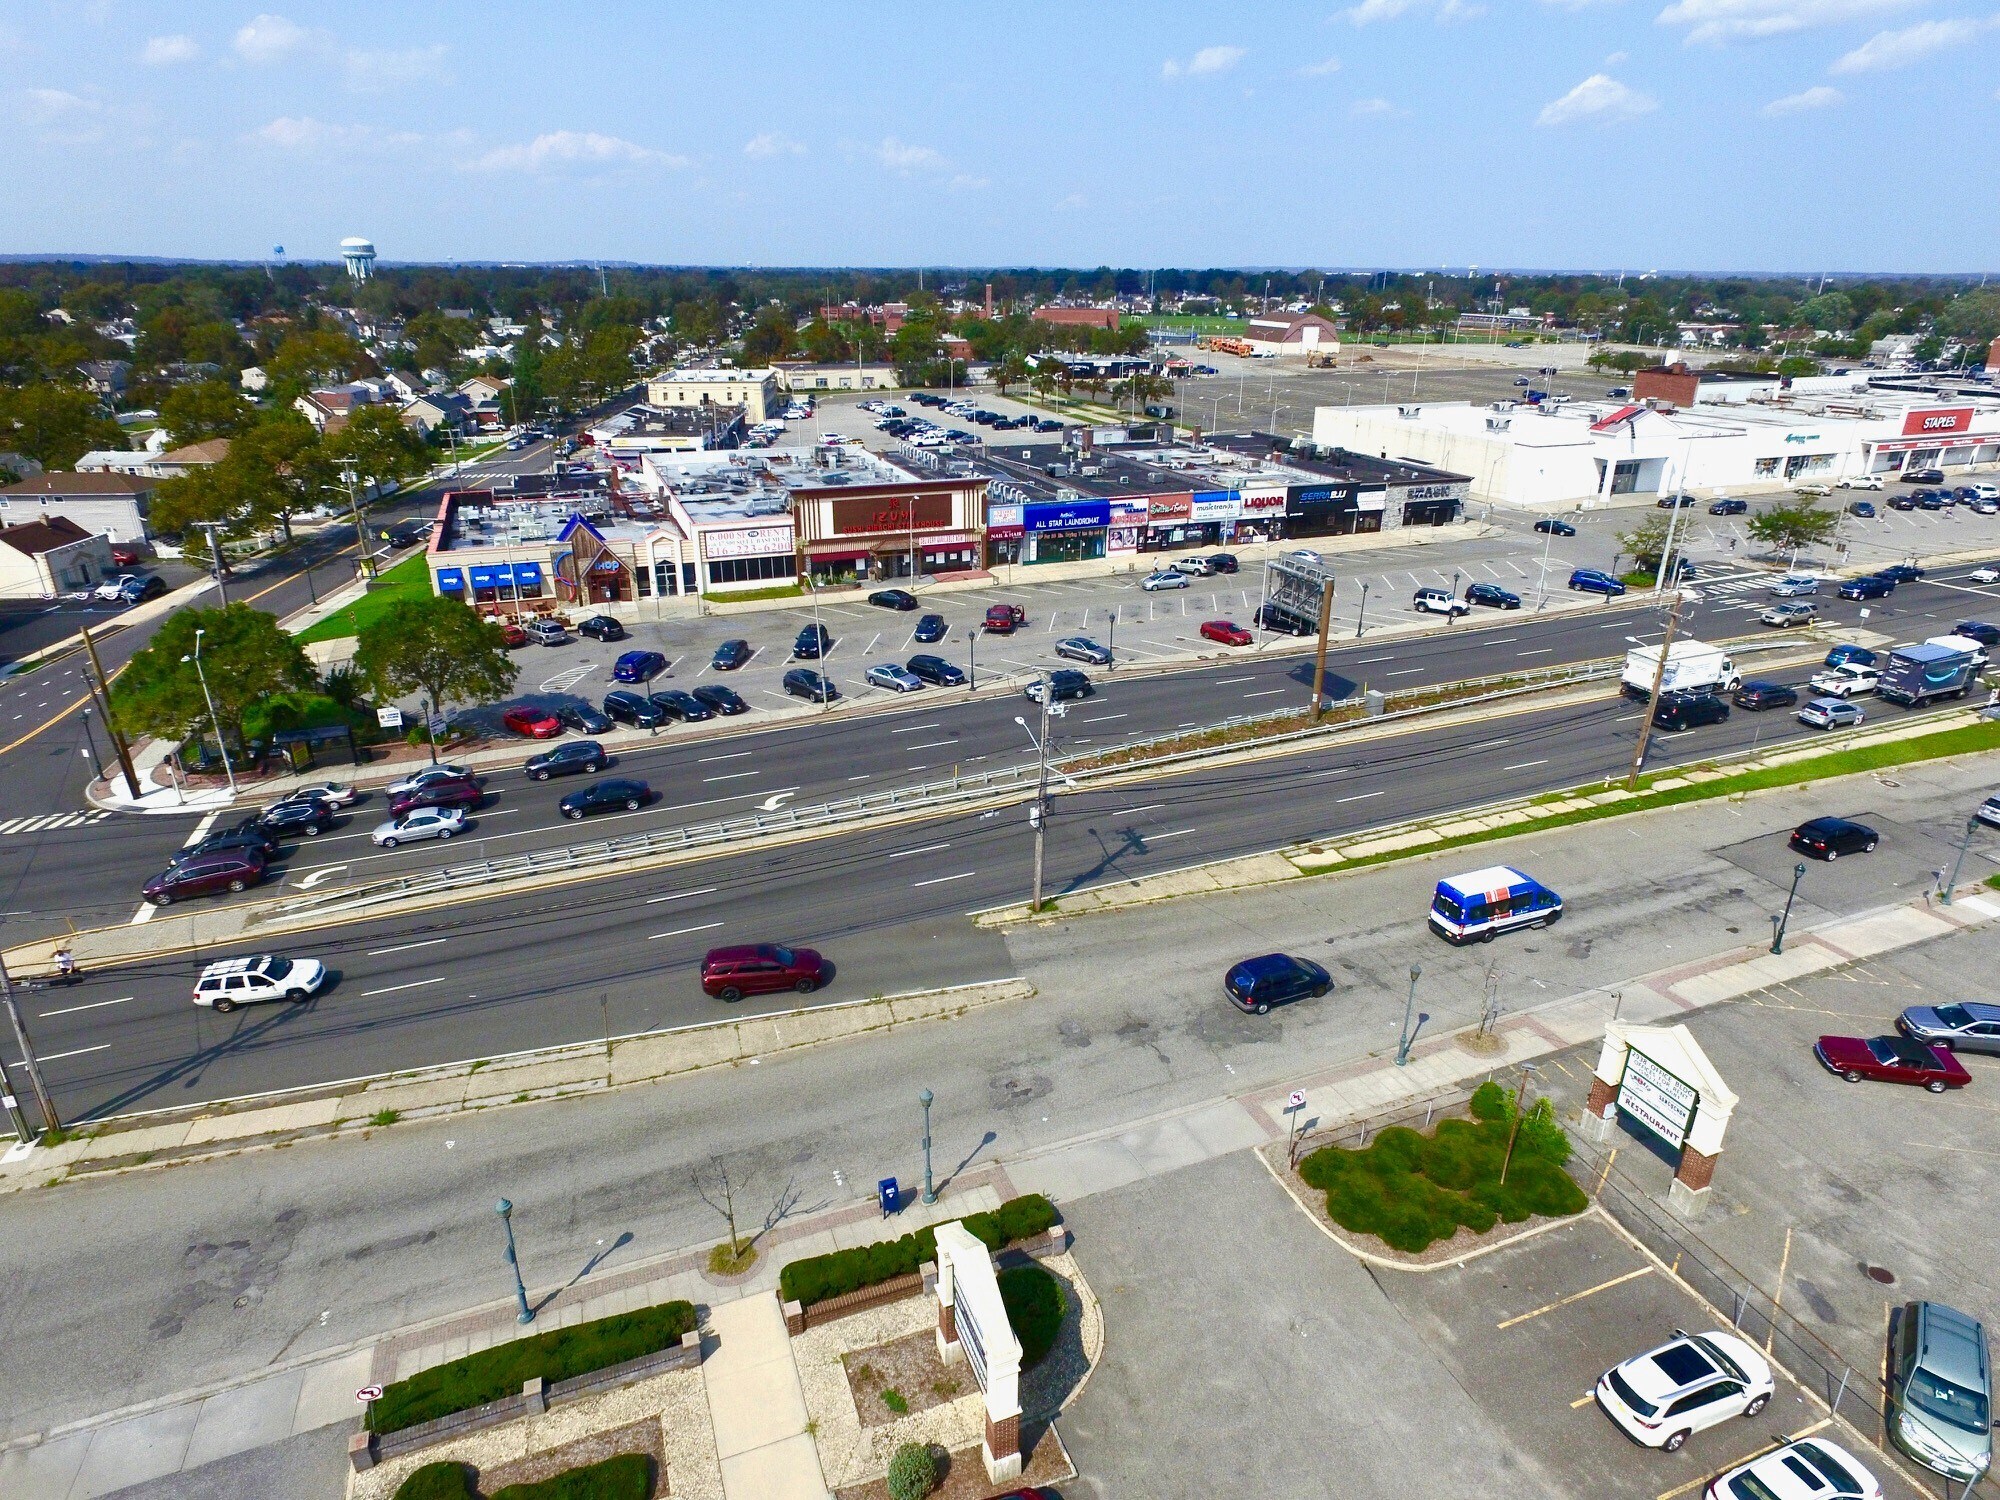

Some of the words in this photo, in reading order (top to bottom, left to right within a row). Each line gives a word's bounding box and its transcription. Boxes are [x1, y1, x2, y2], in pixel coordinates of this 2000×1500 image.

[1923, 416, 1957, 429] STAPLES
[1244, 496, 1284, 508] LIQUOR
[1048, 519, 1062, 527] STAR
[1064, 517, 1100, 526] LAUNDROMAT
[760, 529, 786, 537] RENT
[1631, 1052, 1647, 1065] 2938
[1650, 1064, 1672, 1083] OFFICE
[1625, 1098, 1680, 1141] RESTAURANT
